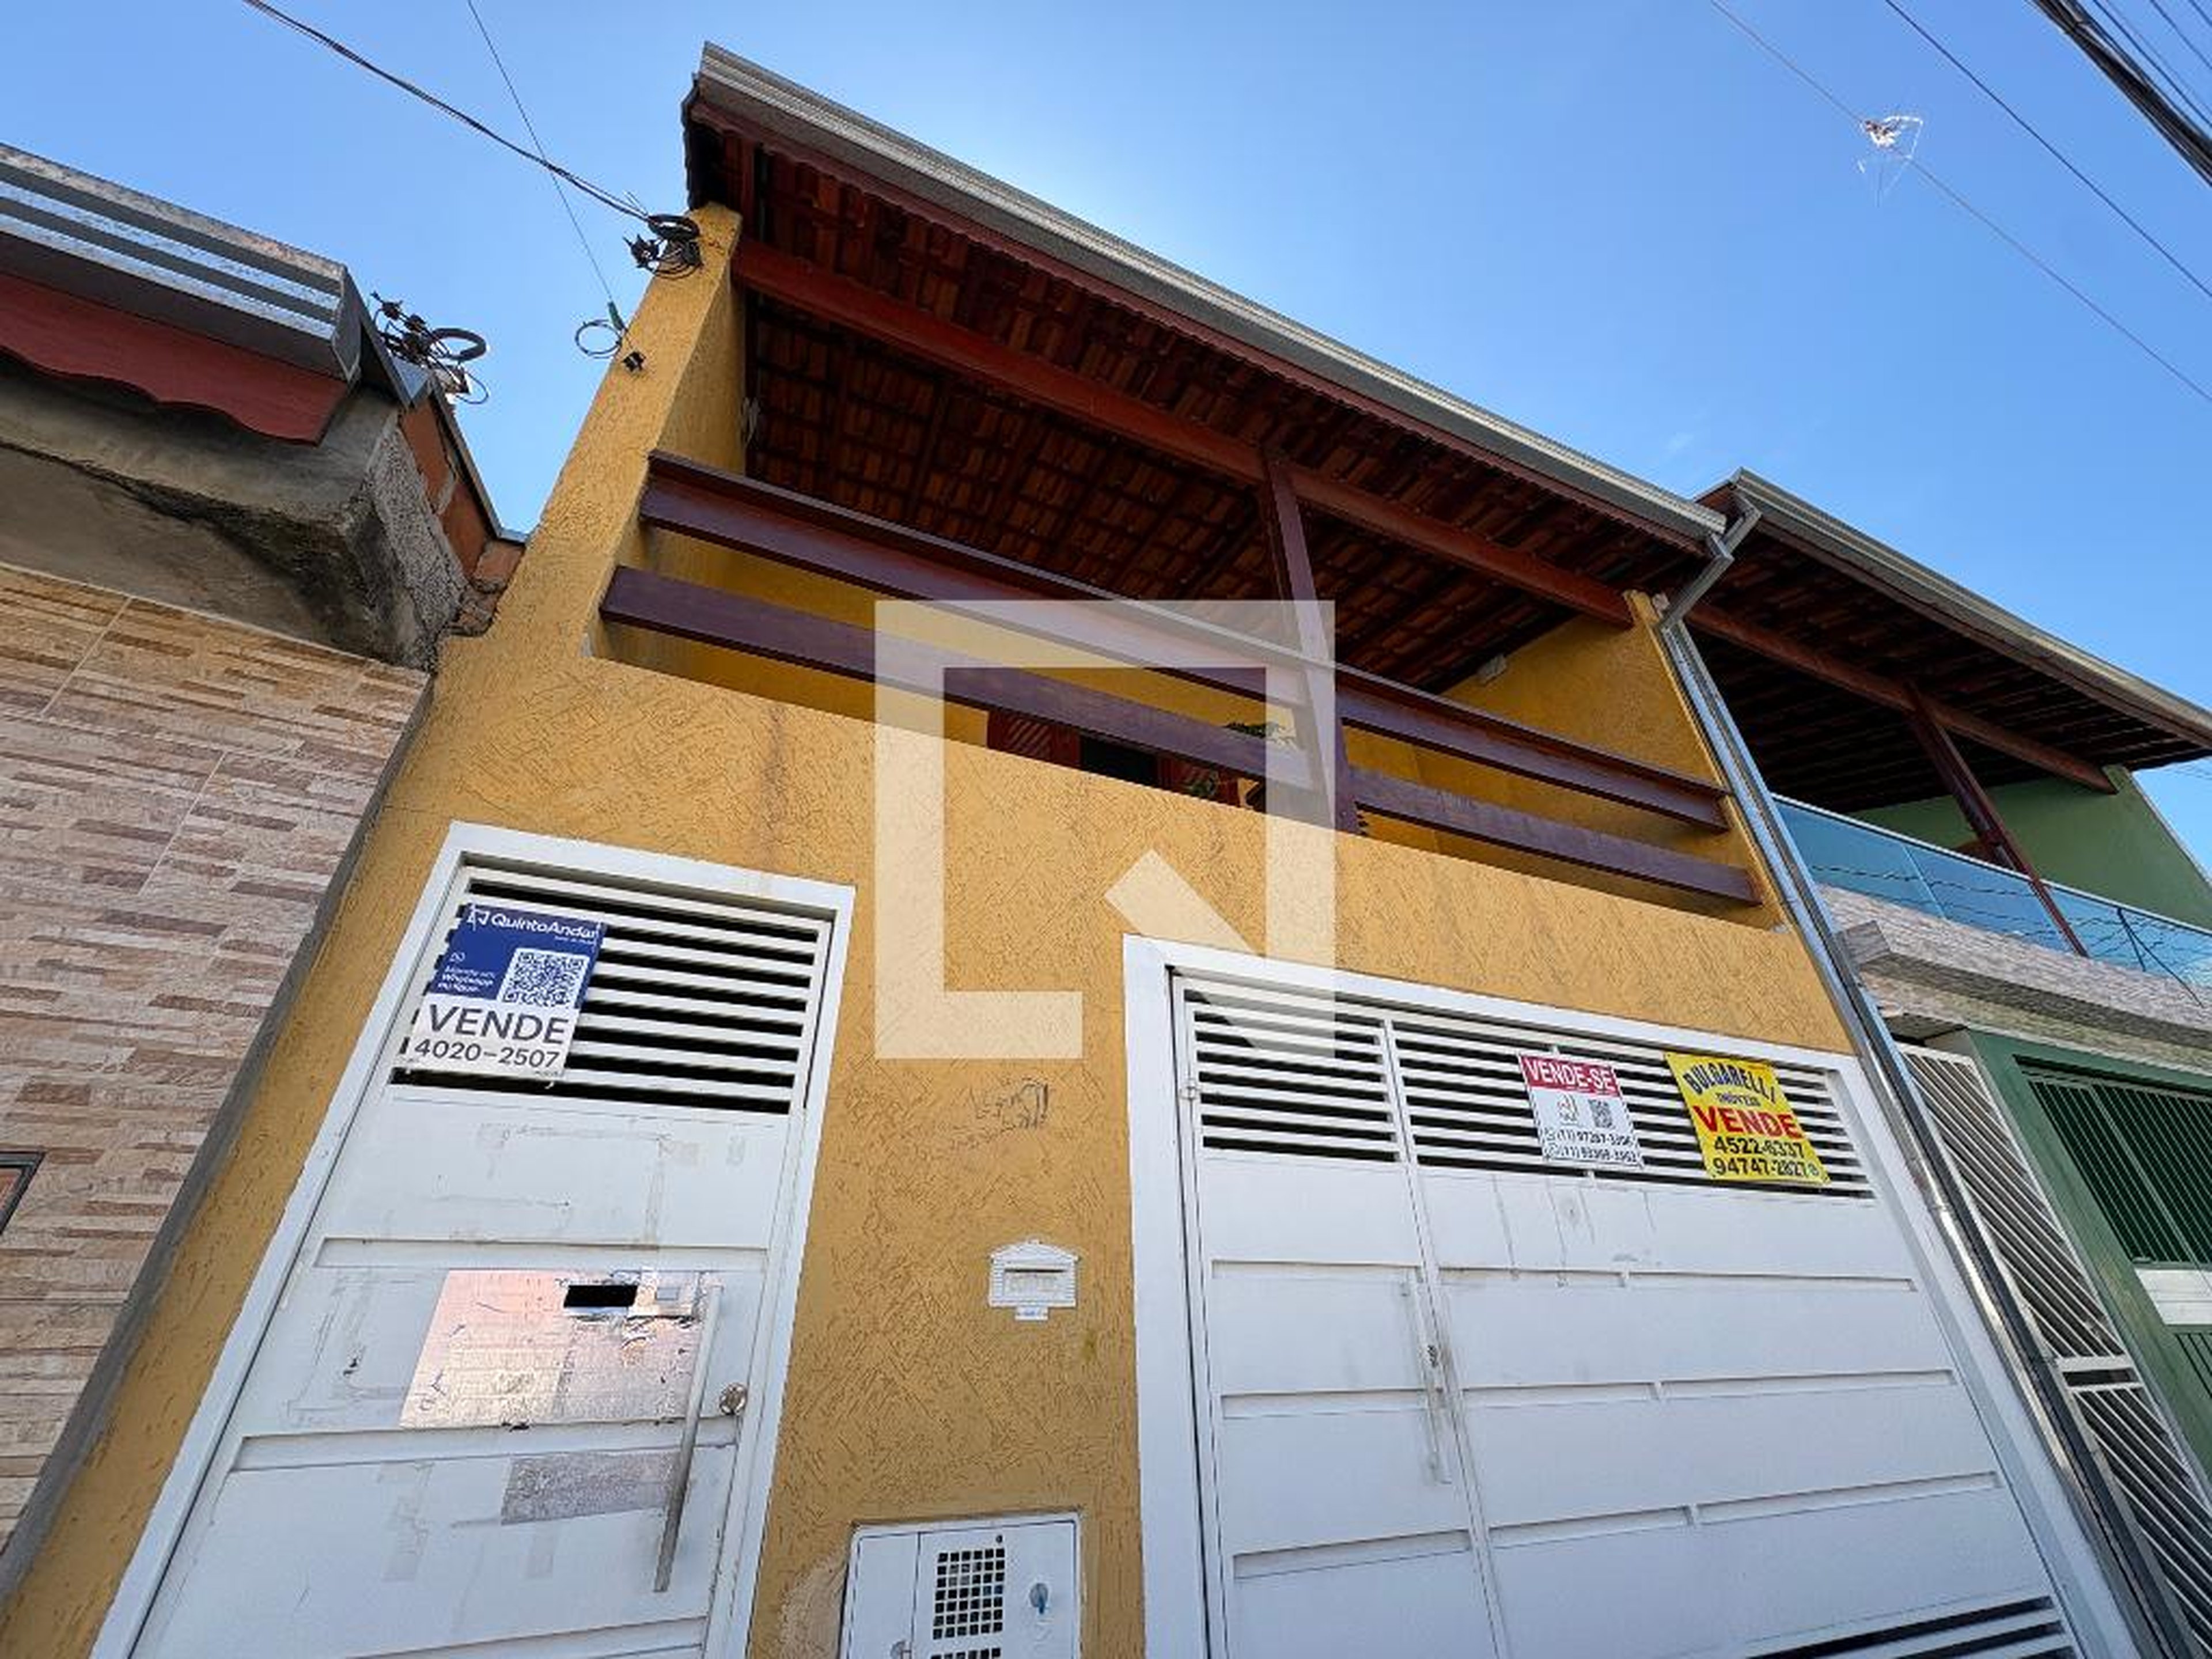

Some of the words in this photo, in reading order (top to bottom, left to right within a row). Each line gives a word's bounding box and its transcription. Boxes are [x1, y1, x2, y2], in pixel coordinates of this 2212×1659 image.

[491, 912, 598, 940] QuintoAndar
[430, 1004, 569, 1045] VENDE
[414, 1039, 560, 1069] 4020-2507
[1524, 1058, 1615, 1091] VENDE-SE
[1694, 1105, 1804, 1139] VENDE
